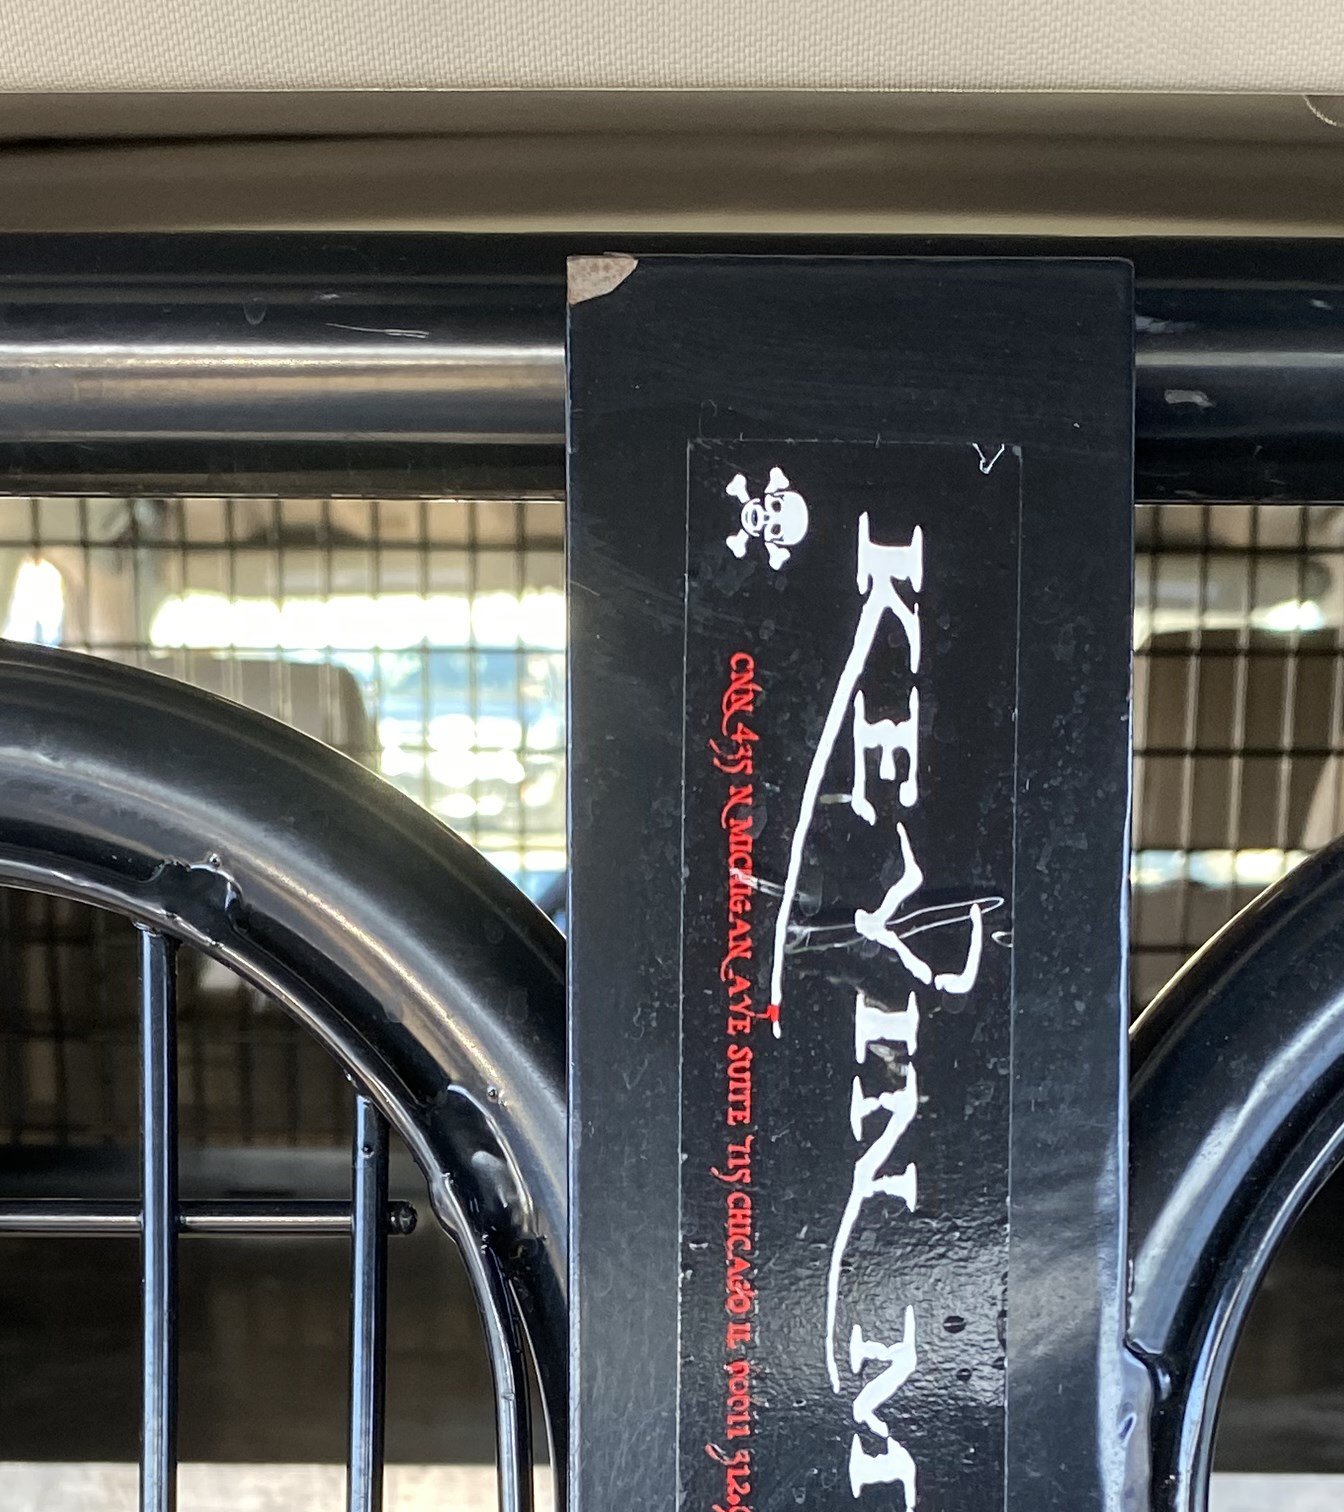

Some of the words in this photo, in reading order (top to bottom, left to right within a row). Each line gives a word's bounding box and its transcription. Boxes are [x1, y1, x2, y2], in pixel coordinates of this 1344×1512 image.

[720, 652, 761, 737] CNN
[709, 722, 760, 777] 435
[720, 784, 753, 829] N
[719, 816, 754, 981] MICHIGAN
[772, 512, 983, 1394] KEVIN
[726, 968, 769, 1036] AVE
[726, 1043, 754, 1127] SUITE
[710, 1135, 754, 1185] 715
[726, 1191, 756, 1316] CHICAGO
[726, 1322, 752, 1350] IL
